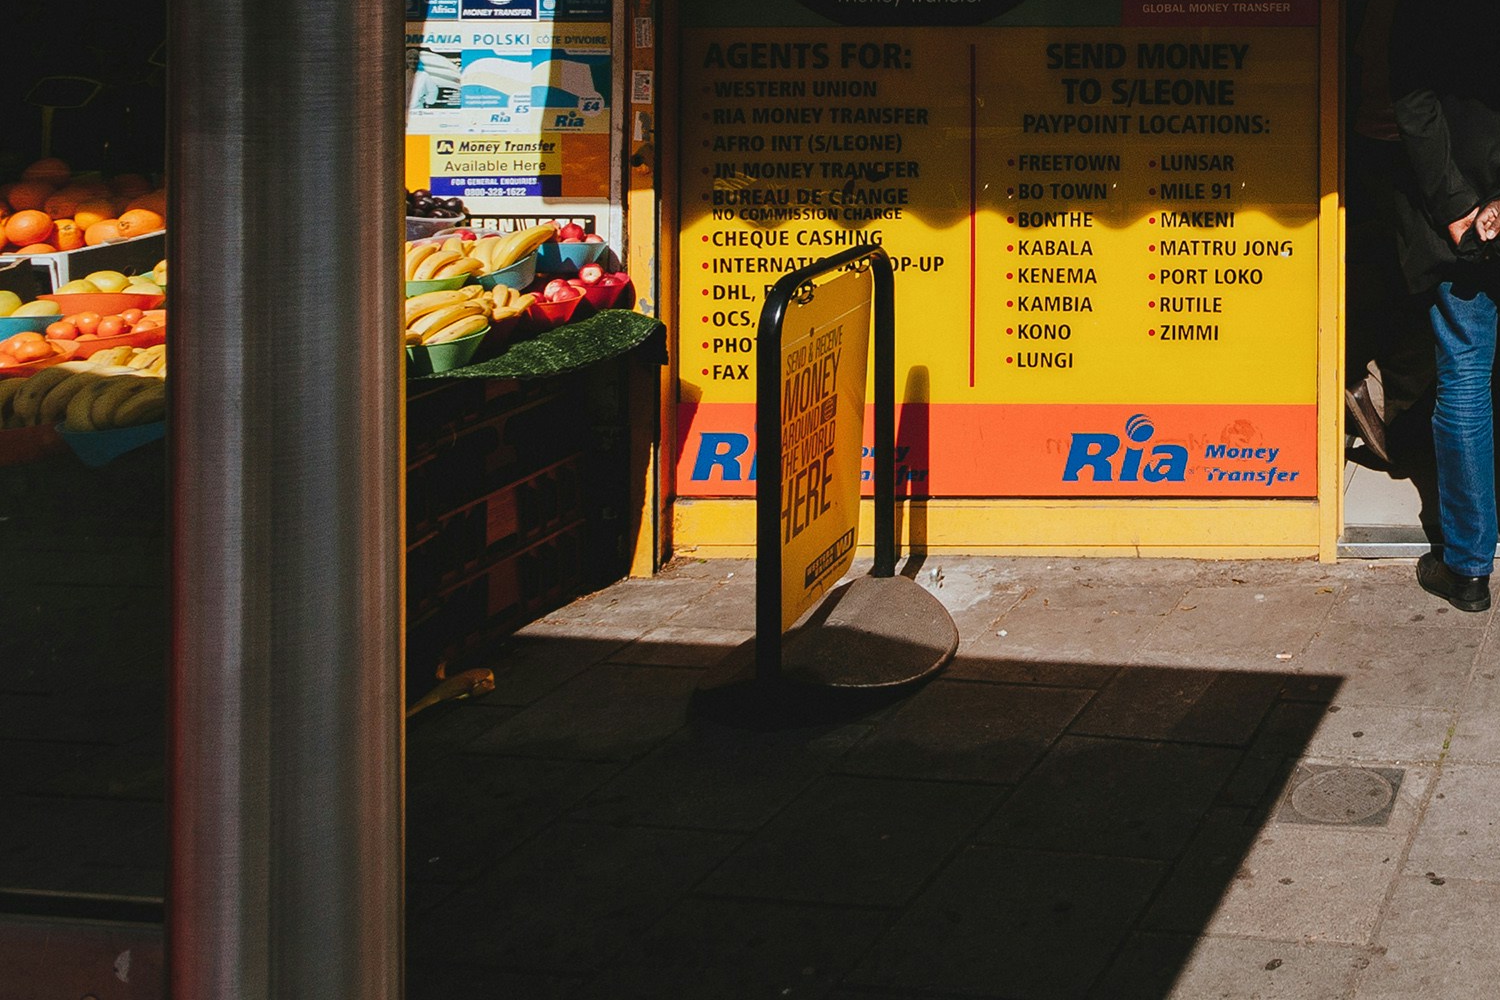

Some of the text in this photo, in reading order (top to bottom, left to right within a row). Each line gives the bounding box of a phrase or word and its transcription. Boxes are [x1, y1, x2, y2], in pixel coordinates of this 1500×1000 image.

[1142, 2, 1292, 14] GLOBAL MONEY TRANSFER
[472, 33, 530, 45] POLSKI
[703, 42, 913, 70] AGENTS FOR:
[1045, 42, 1250, 71] SEND MONEY
[714, 80, 878, 98] WESTERN UNION
[1061, 78, 1235, 108] TO S/LEONE
[490, 111, 511, 123] Ria
[554, 110, 585, 128] Ria
[712, 107, 929, 126] RIA MONEY TRANSFER
[1022, 114, 1271, 136] PAYPOINT LOCATIONS:
[458, 139, 556, 155] Money Transfer
[712, 134, 804, 152] AFRO INT
[444, 159, 547, 173] Available Here
[745, 162, 815, 179] MONEY
[1018, 154, 1121, 172] FREETOWN
[1160, 154, 1235, 172] LUNSAR
[712, 188, 823, 206] BUREAU DE
[1018, 183, 1108, 200] BO TOWN
[1160, 183, 1231, 200] MILE 91
[712, 207, 903, 221] NO COMMISSION CHARGE
[1018, 211, 1094, 228] BONTHE
[1160, 211, 1235, 228] MAKENI
[712, 229, 883, 248] CHEQUE CASHING
[1018, 240, 1094, 257] KABALA
[1160, 240, 1294, 257] MATTRU JONG
[1017, 267, 1098, 285] KENEMA
[1159, 269, 1264, 285] PORT LOKO
[712, 284, 757, 302] DHL,
[1017, 296, 1094, 313] KAMBIA
[1159, 297, 1223, 313] RUTILE
[1017, 324, 1072, 341] KONO
[1159, 325, 1220, 341] ZIMMI
[1017, 352, 1074, 369] LUNGI
[712, 364, 750, 381] FAX
[782, 347, 842, 427] MONEY
[781, 405, 821, 452] AROUND
[801, 420, 836, 469] WORLD
[1061, 413, 1190, 483] Ria
[1204, 444, 1280, 461] Money
[1206, 466, 1300, 487] Transfer
